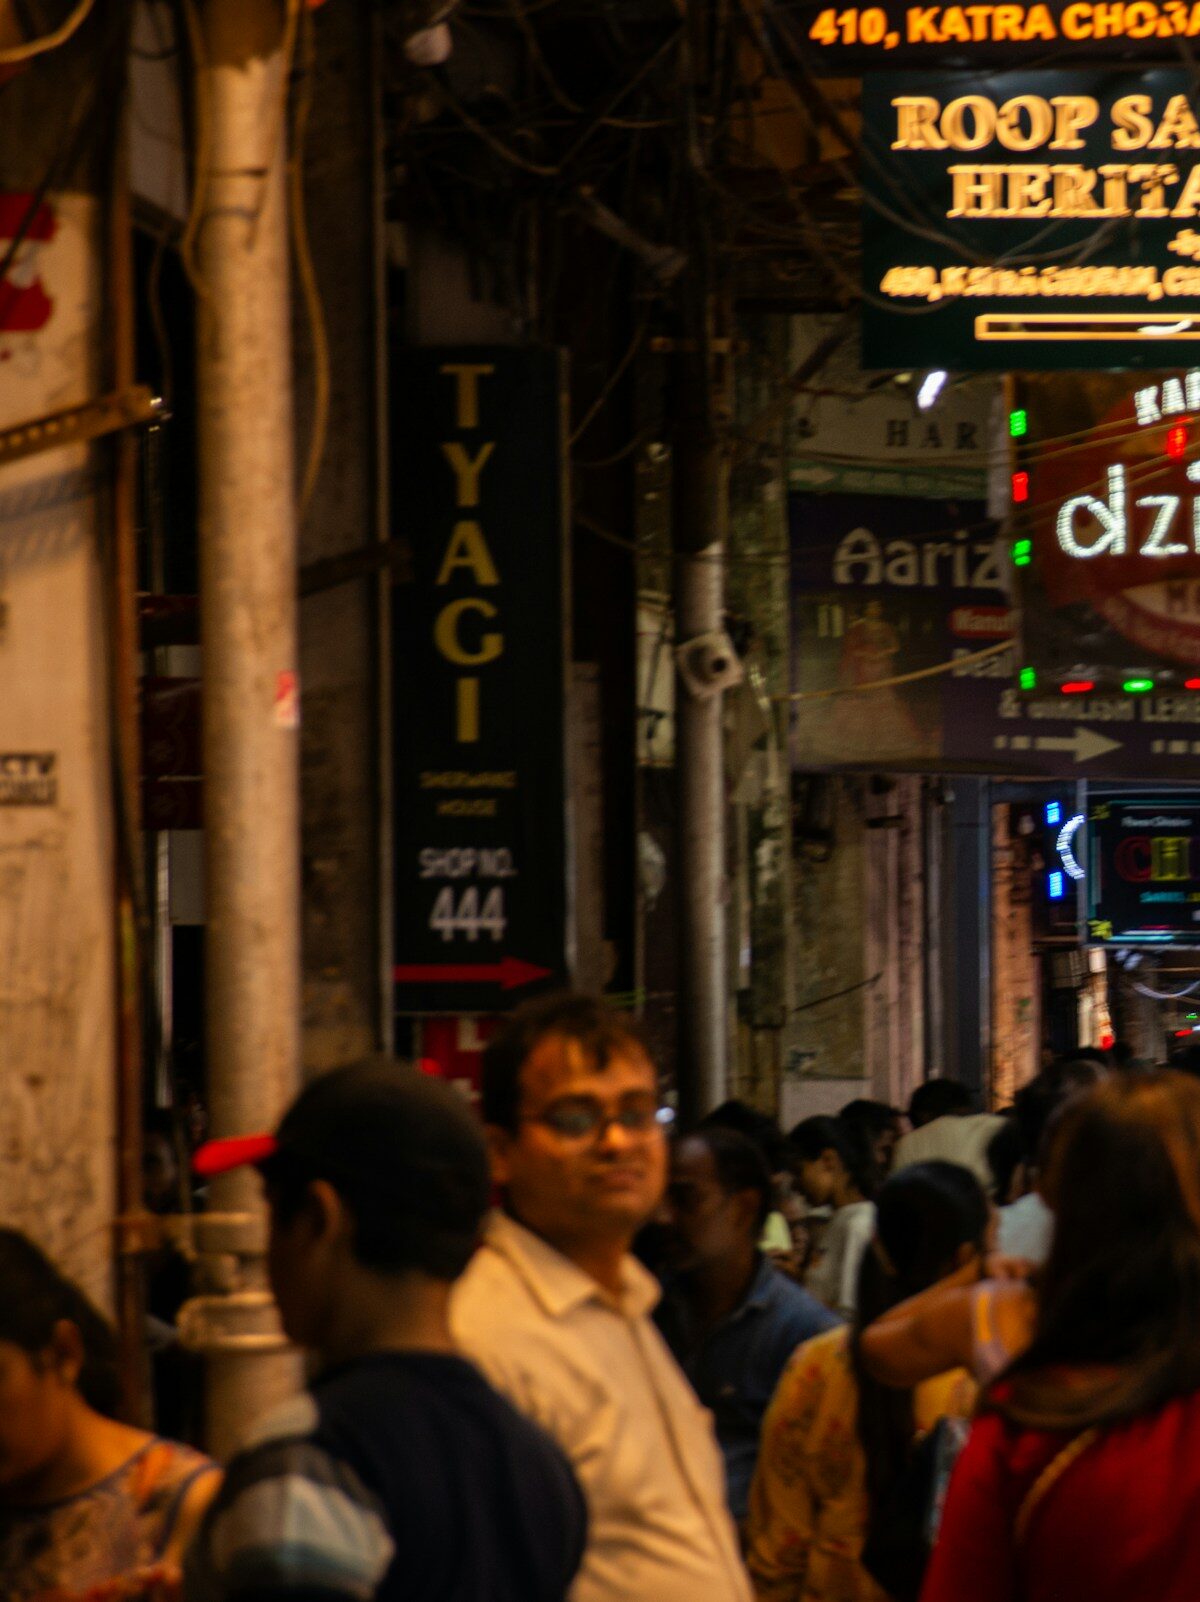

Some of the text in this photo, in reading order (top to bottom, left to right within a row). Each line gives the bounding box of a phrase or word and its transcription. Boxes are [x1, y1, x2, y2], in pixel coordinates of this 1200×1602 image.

[809, 8, 901, 51] 410,
[906, 4, 1058, 44] KATRA
[891, 95, 1101, 153] ROOP
[434, 363, 502, 743] TYAGI
[418, 848, 477, 880] SHOP
[429, 886, 507, 942] 444
